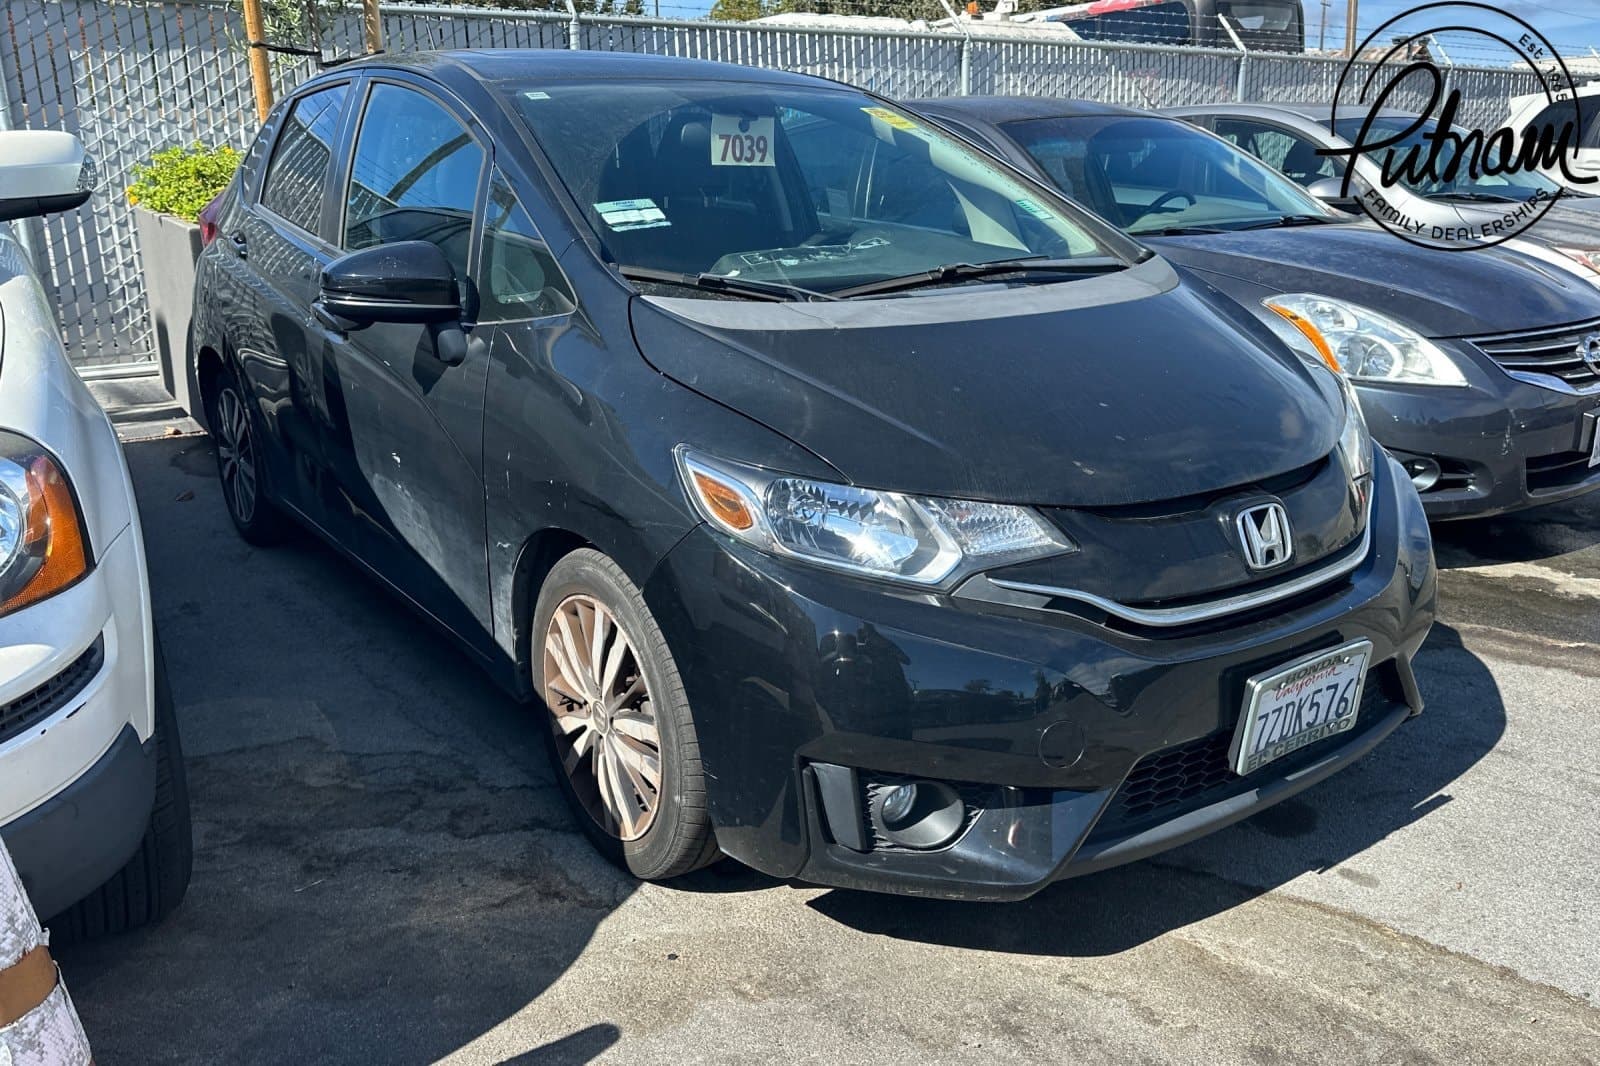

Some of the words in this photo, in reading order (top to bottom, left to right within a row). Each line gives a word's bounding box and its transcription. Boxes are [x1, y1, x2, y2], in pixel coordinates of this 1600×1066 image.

[719, 134, 768, 163] 7039
[1286, 654, 1342, 683] HONDA
[1254, 678, 1354, 755] 7ZDK576
[1247, 752, 1267, 771] EL
